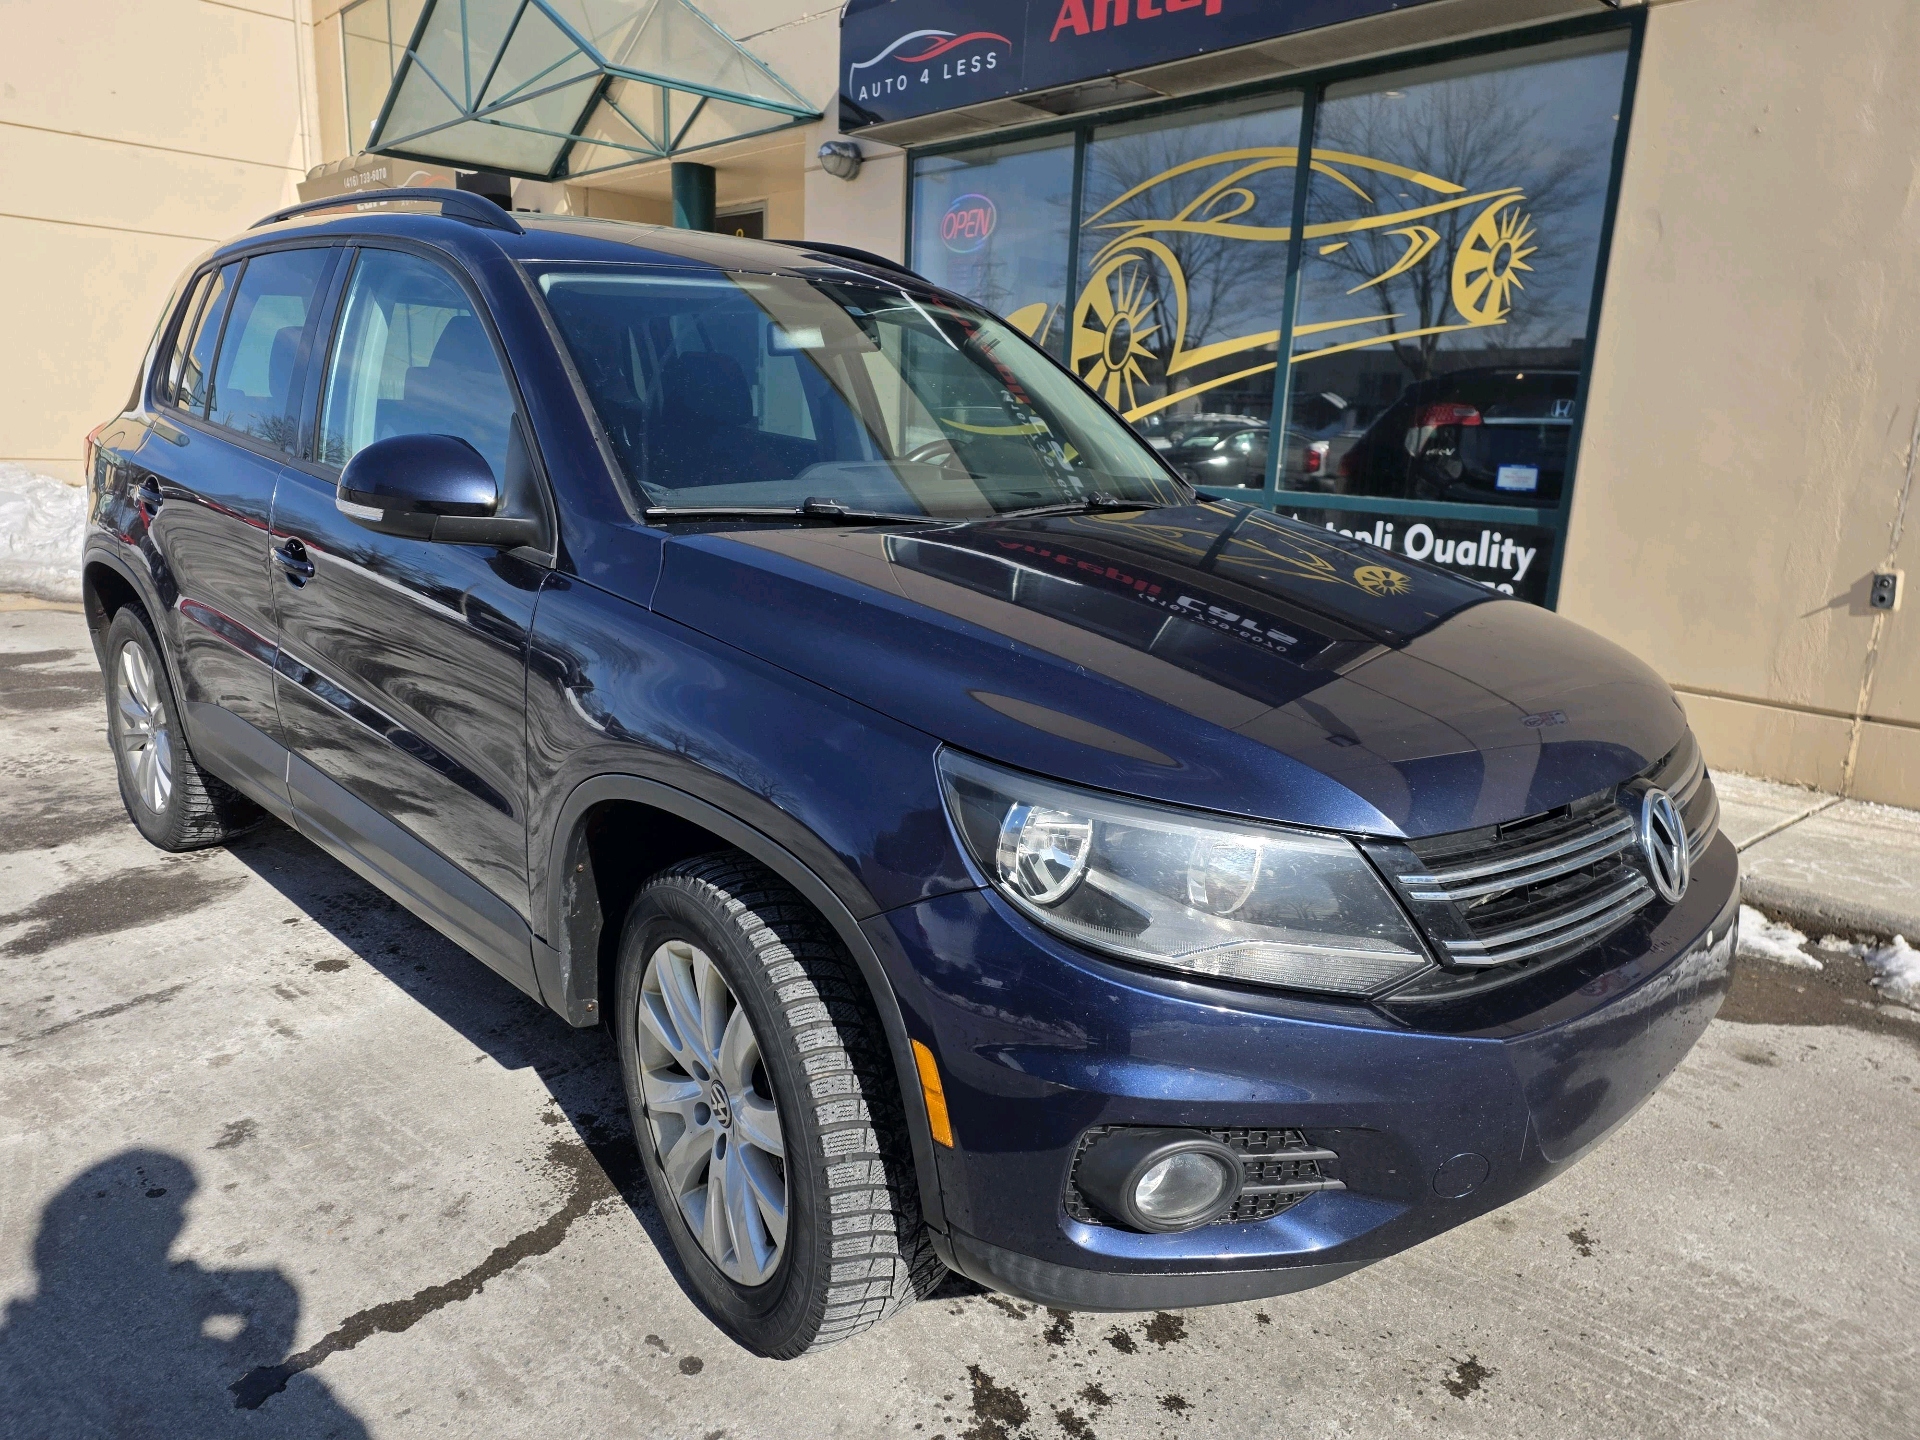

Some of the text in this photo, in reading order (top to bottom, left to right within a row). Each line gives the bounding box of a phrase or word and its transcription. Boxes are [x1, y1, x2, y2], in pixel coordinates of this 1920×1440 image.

[858, 51, 997, 101] AUTO 4 LESS
[942, 207, 992, 240] OPEN
[1403, 522, 1537, 581] Quality
